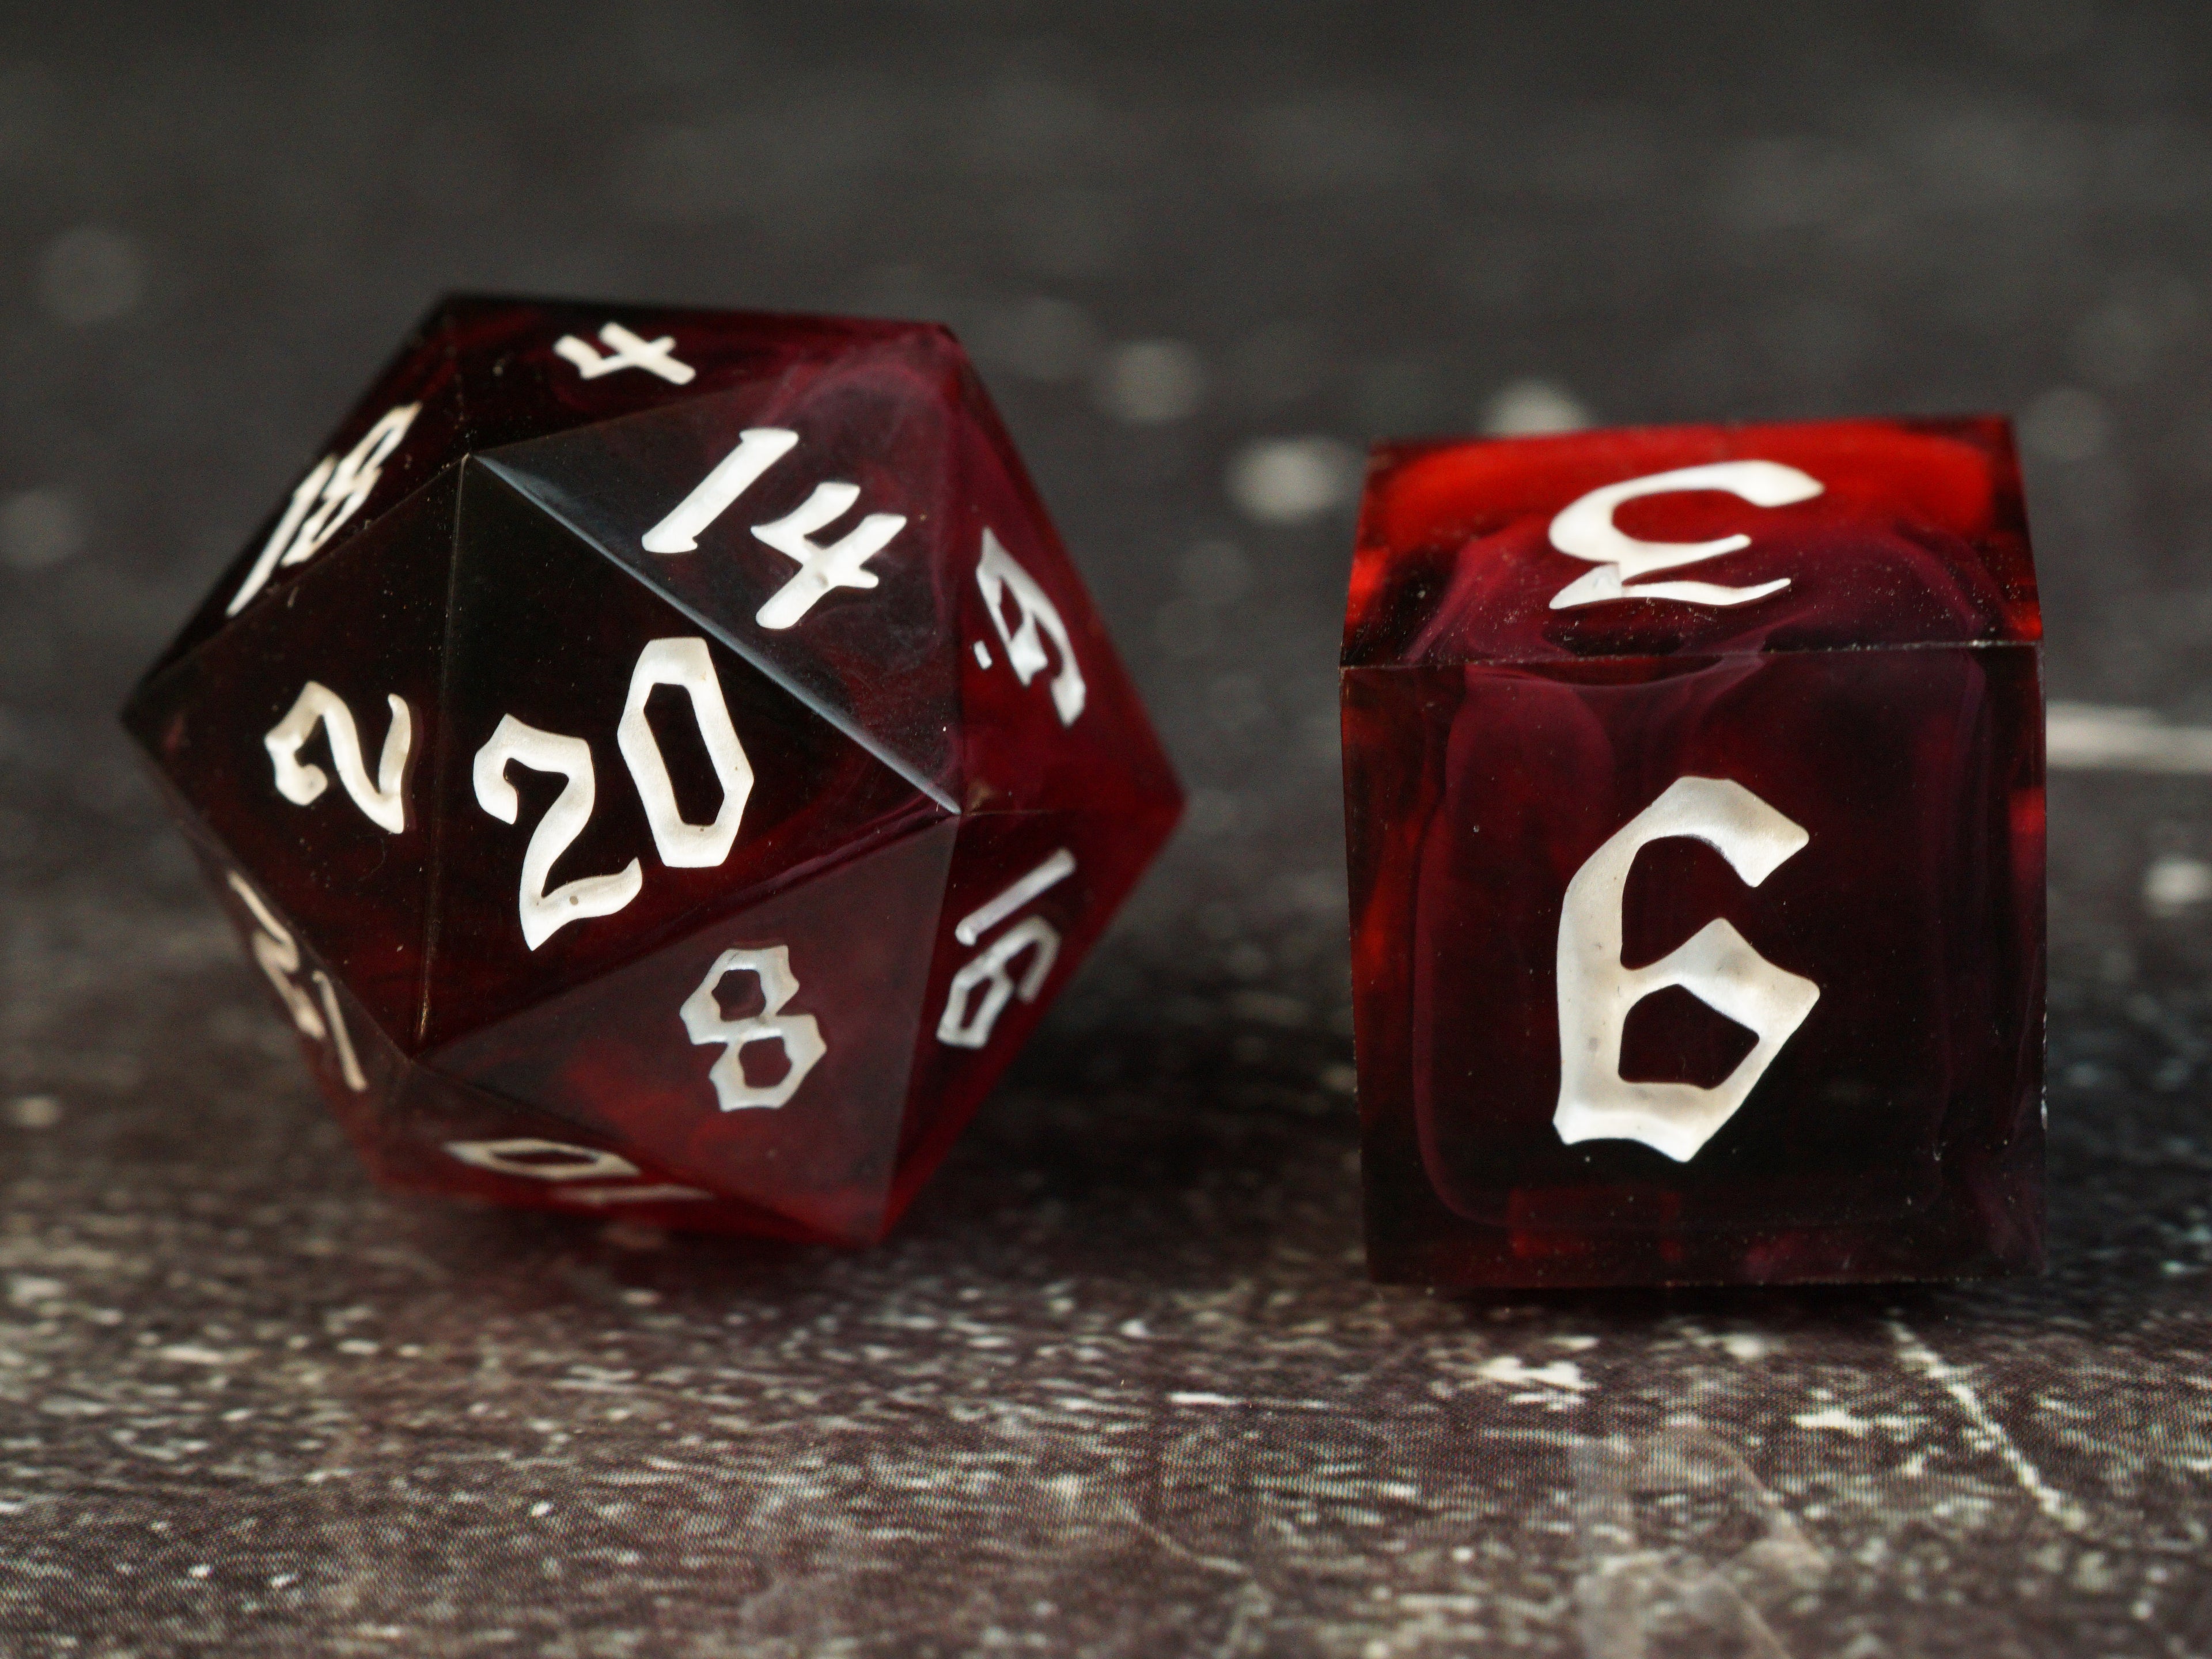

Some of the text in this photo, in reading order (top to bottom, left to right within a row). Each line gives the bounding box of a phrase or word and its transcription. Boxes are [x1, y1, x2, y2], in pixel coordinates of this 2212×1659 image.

[553, 321, 696, 385] 4
[226, 402, 422, 616] 18
[641, 425, 908, 631] 14
[1548, 459, 1824, 609] 3
[263, 681, 412, 835] 2
[472, 637, 755, 952] 20
[678, 945, 827, 1113] 8
[937, 849, 1075, 1048] 16
[1552, 776, 1821, 1163] 6
